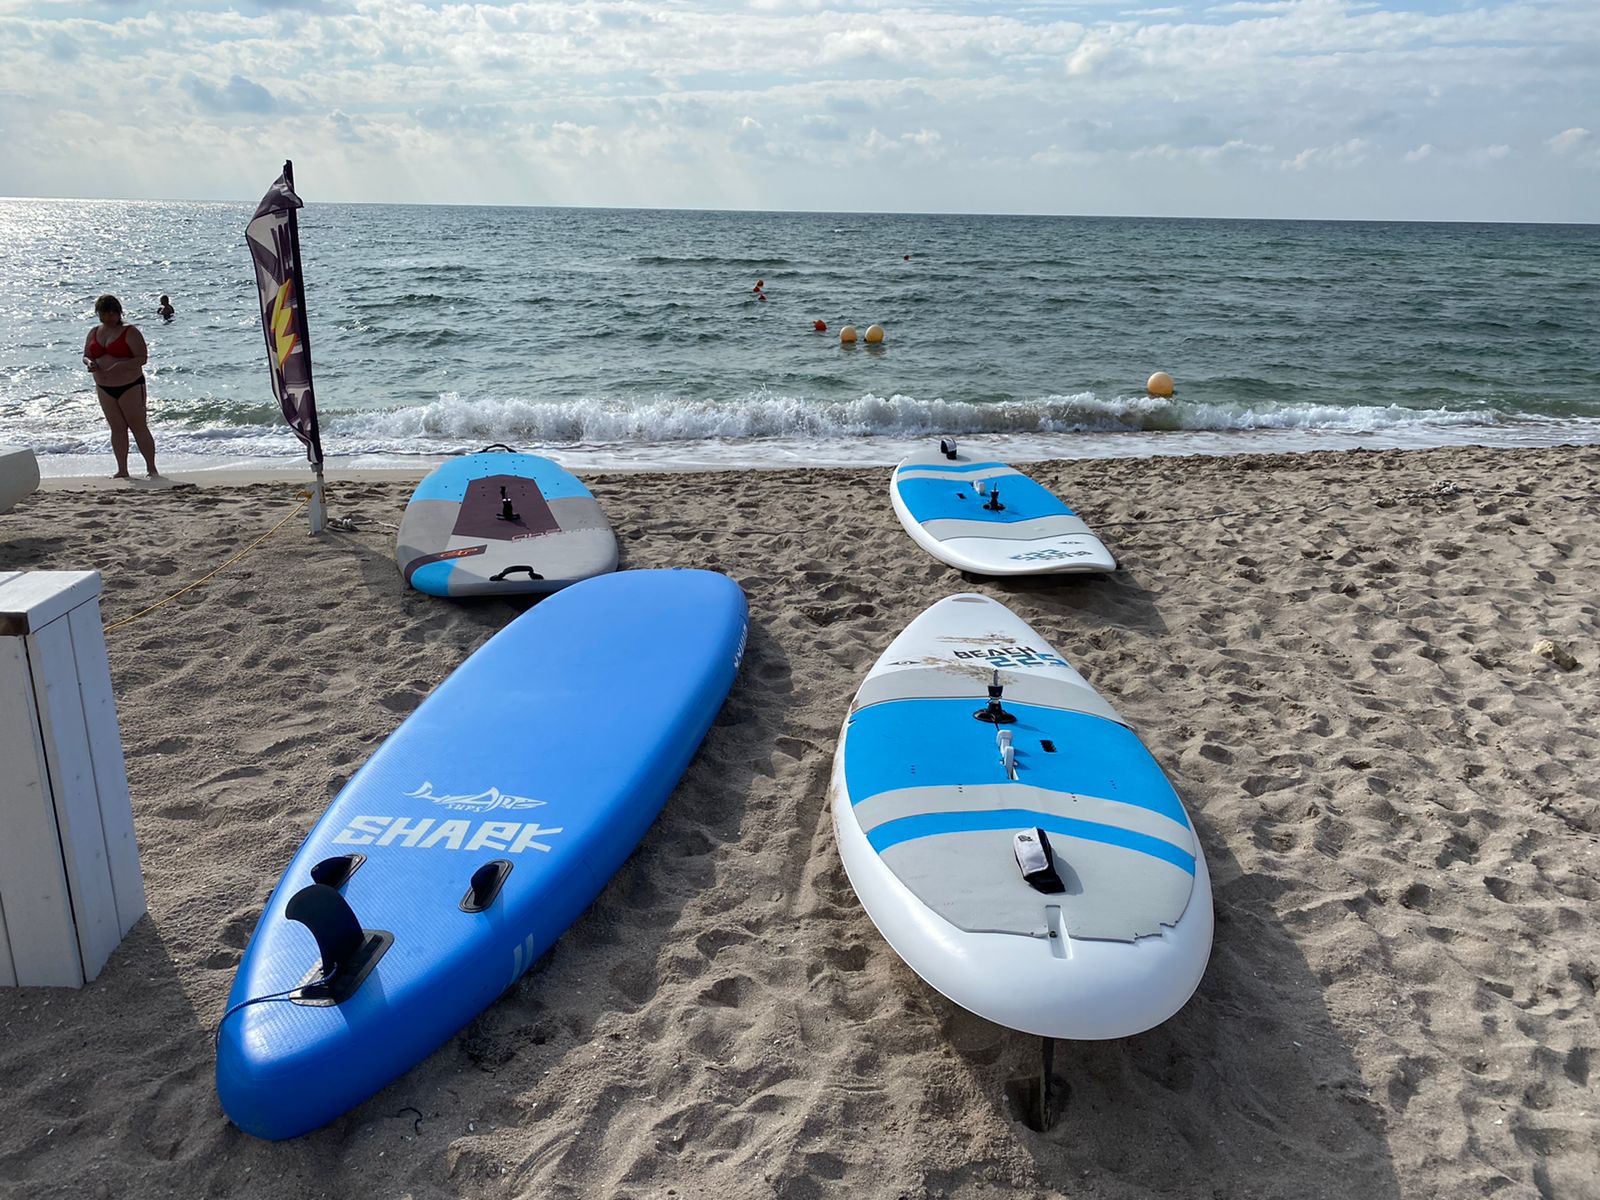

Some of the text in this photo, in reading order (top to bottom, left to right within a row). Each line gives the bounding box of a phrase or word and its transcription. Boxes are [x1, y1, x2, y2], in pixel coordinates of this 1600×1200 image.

[953, 646, 1037, 660] BEACH
[984, 652, 1071, 668] 225
[331, 815, 563, 854] SHARK
